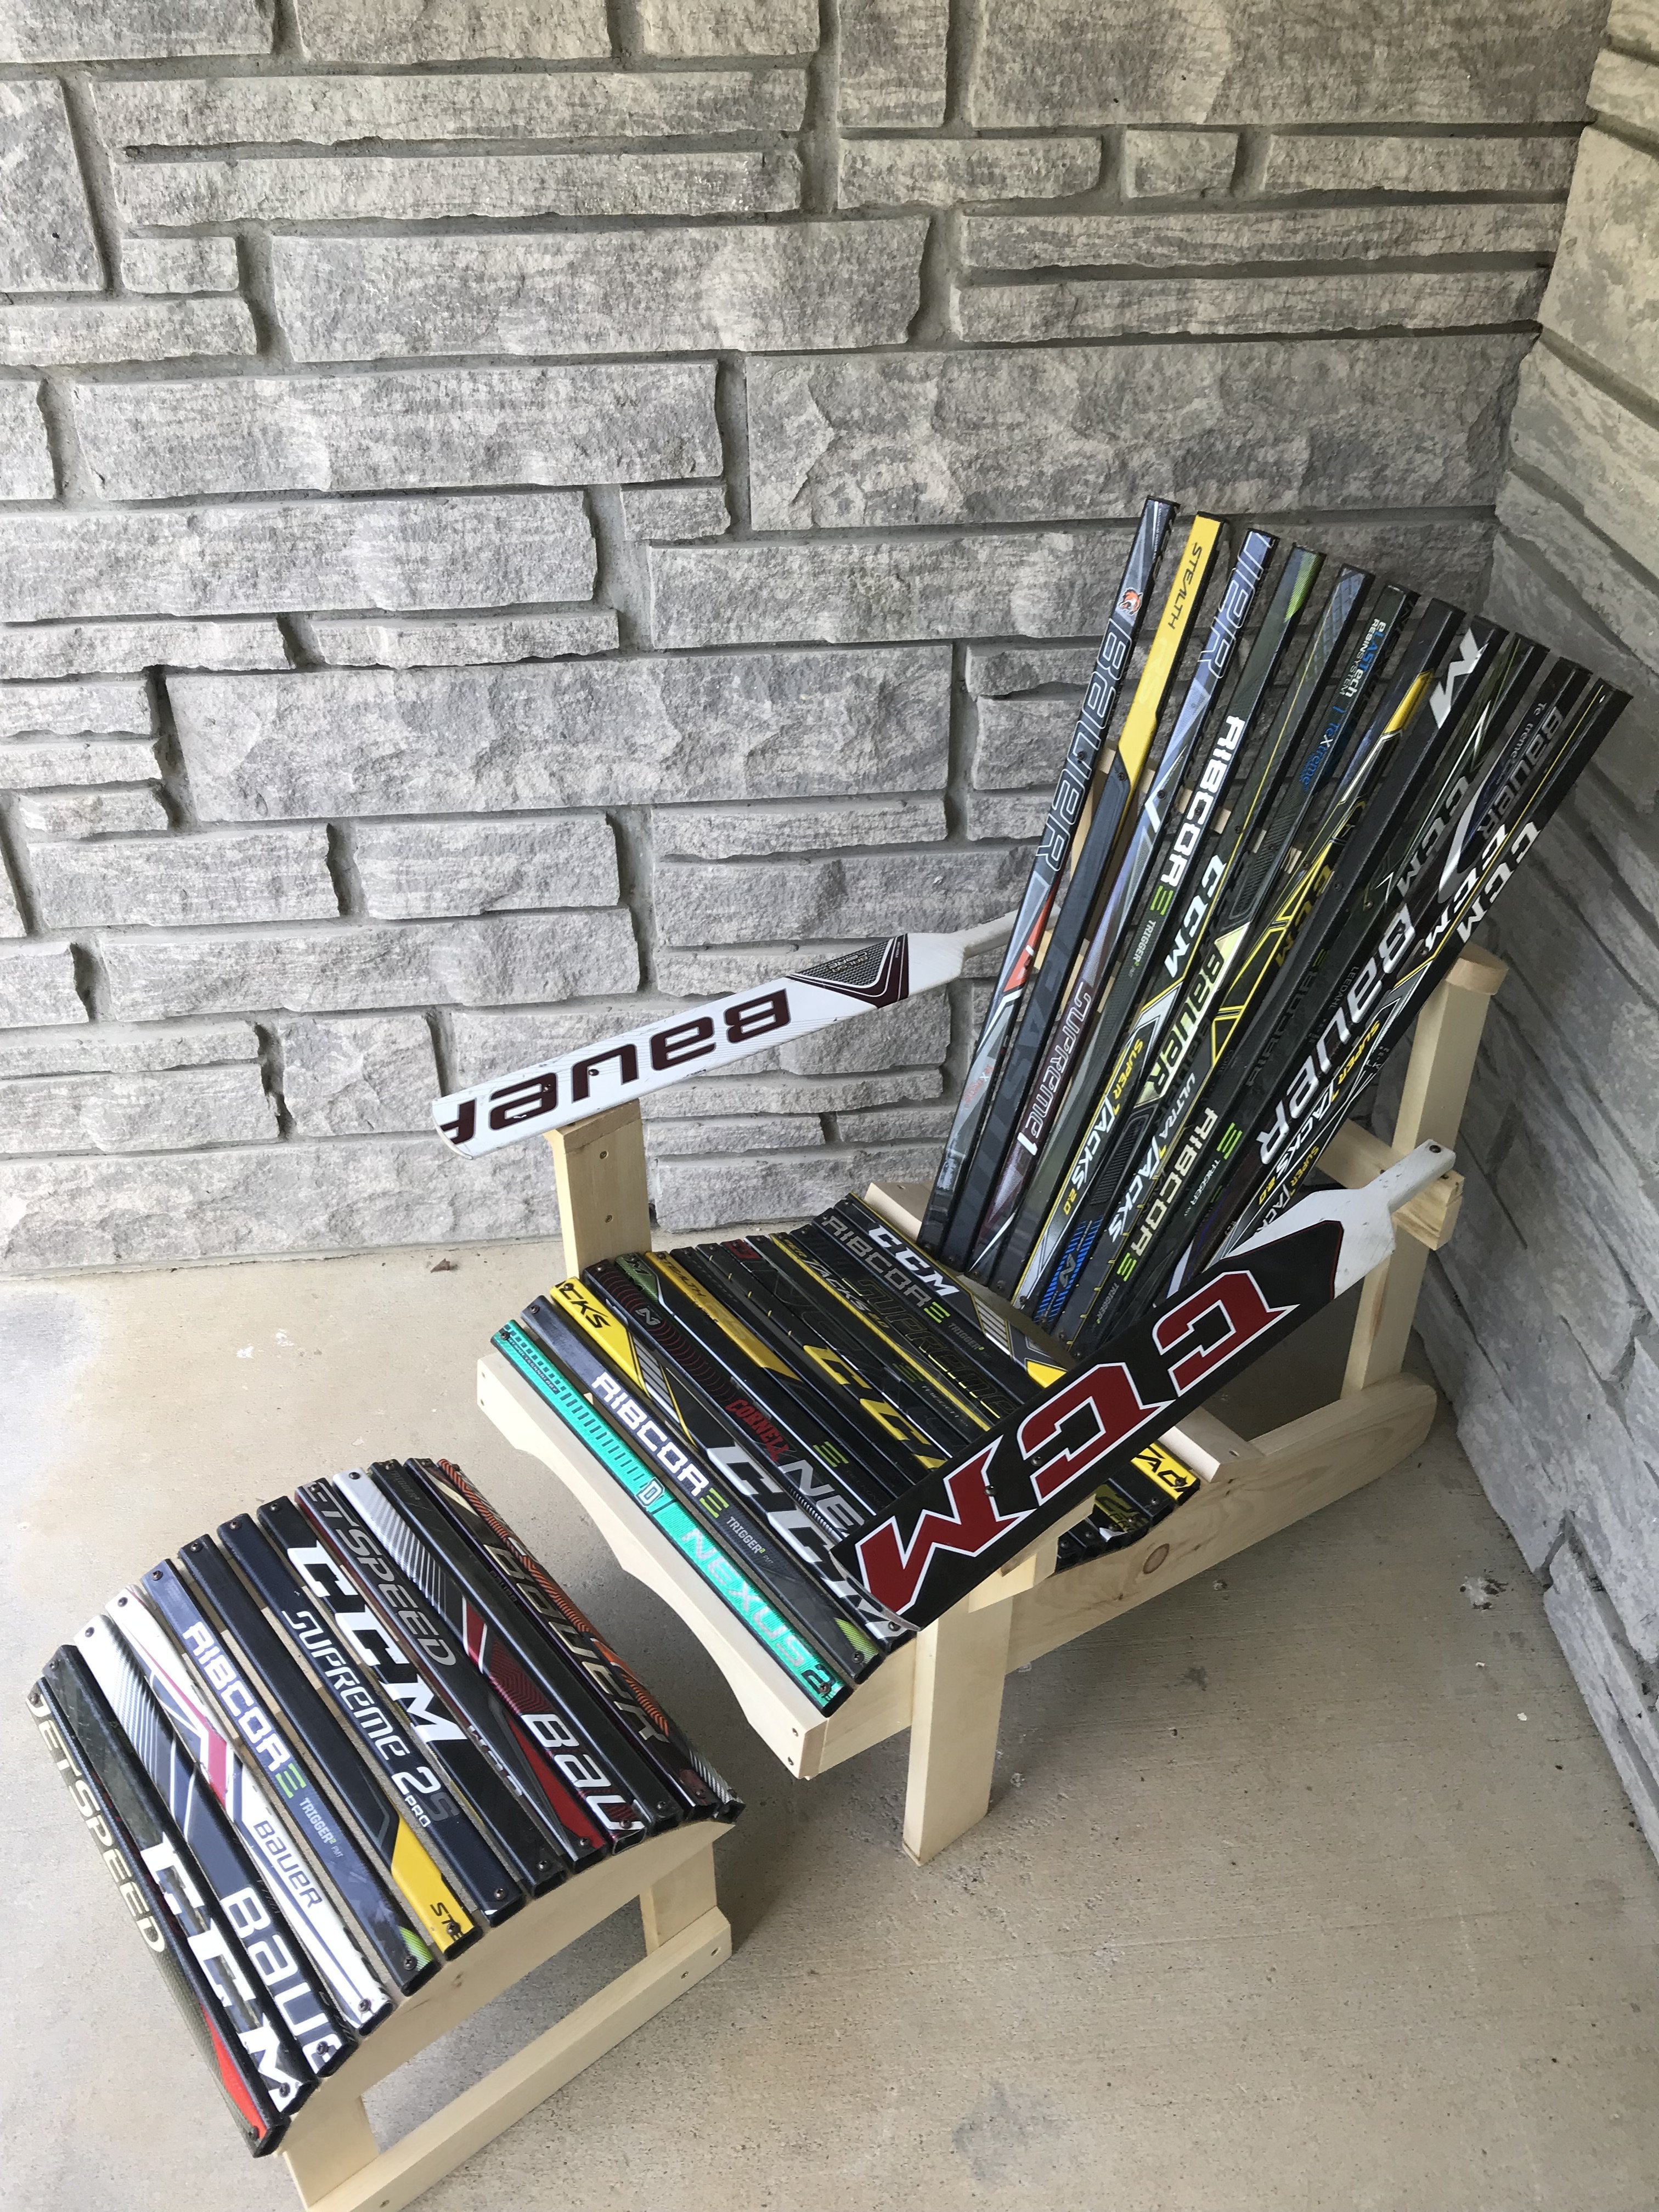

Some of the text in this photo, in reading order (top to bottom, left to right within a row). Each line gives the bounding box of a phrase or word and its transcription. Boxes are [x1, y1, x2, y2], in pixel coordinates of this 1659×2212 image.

[1167, 542, 1202, 630] STEALTH
[1397, 776, 1470, 896] CCM
[1425, 823, 1507, 950] CCM
[1457, 822, 1541, 943] CCM
[1164, 855, 1227, 978] CCM
[1275, 865, 1334, 967] CCM
[1256, 902, 1415, 1164] BAUER
[1328, 966, 1359, 1009] LEEDAHL
[1113, 1037, 1144, 1101] SUPER
[1338, 1020, 1380, 1085] SUPER
[1071, 1094, 1121, 1190] TACKS
[1108, 1073, 1197, 1243] ULTRA TACKS
[1275, 1077, 1338, 1180] TACKS
[868, 1224, 961, 1297] CCM
[726, 1398, 790, 1463] CORNELL
[855, 1269, 1301, 1616] CCM
[287, 1539, 469, 1743] CCM
[681, 1528, 814, 1668] NEXUS
[26, 1693, 166, 1953] JETSPEED
[252, 1819, 323, 1909] BAUER
[404, 1796, 431, 1829] PRO
[140, 1831, 303, 2112] CCM
